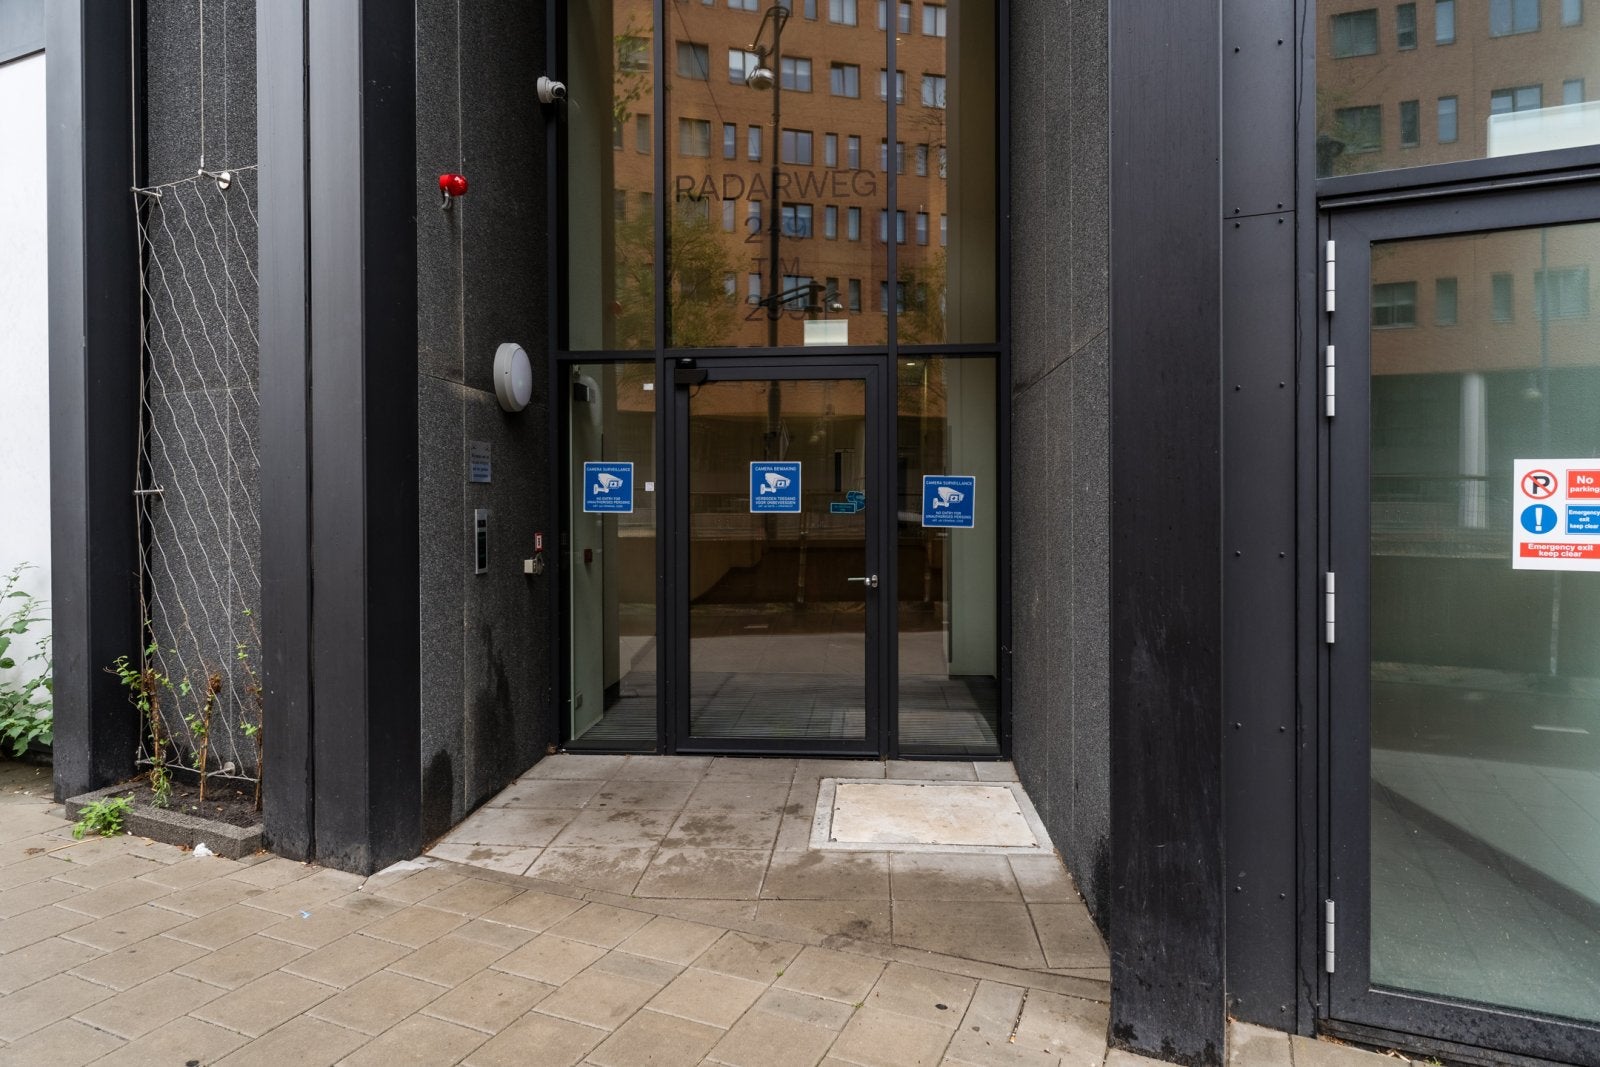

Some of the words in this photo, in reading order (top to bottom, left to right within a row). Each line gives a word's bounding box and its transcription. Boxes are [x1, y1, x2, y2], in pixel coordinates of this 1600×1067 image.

[676, 170, 876, 202] RADARWEG
[1577, 475, 1594, 484] No
[1570, 485, 1600, 494] parking
[1569, 509, 1600, 517] Emergency
[1528, 543, 1575, 552] Emergency
[1577, 543, 1594, 552] exit
[1538, 550, 1559, 558] keep
